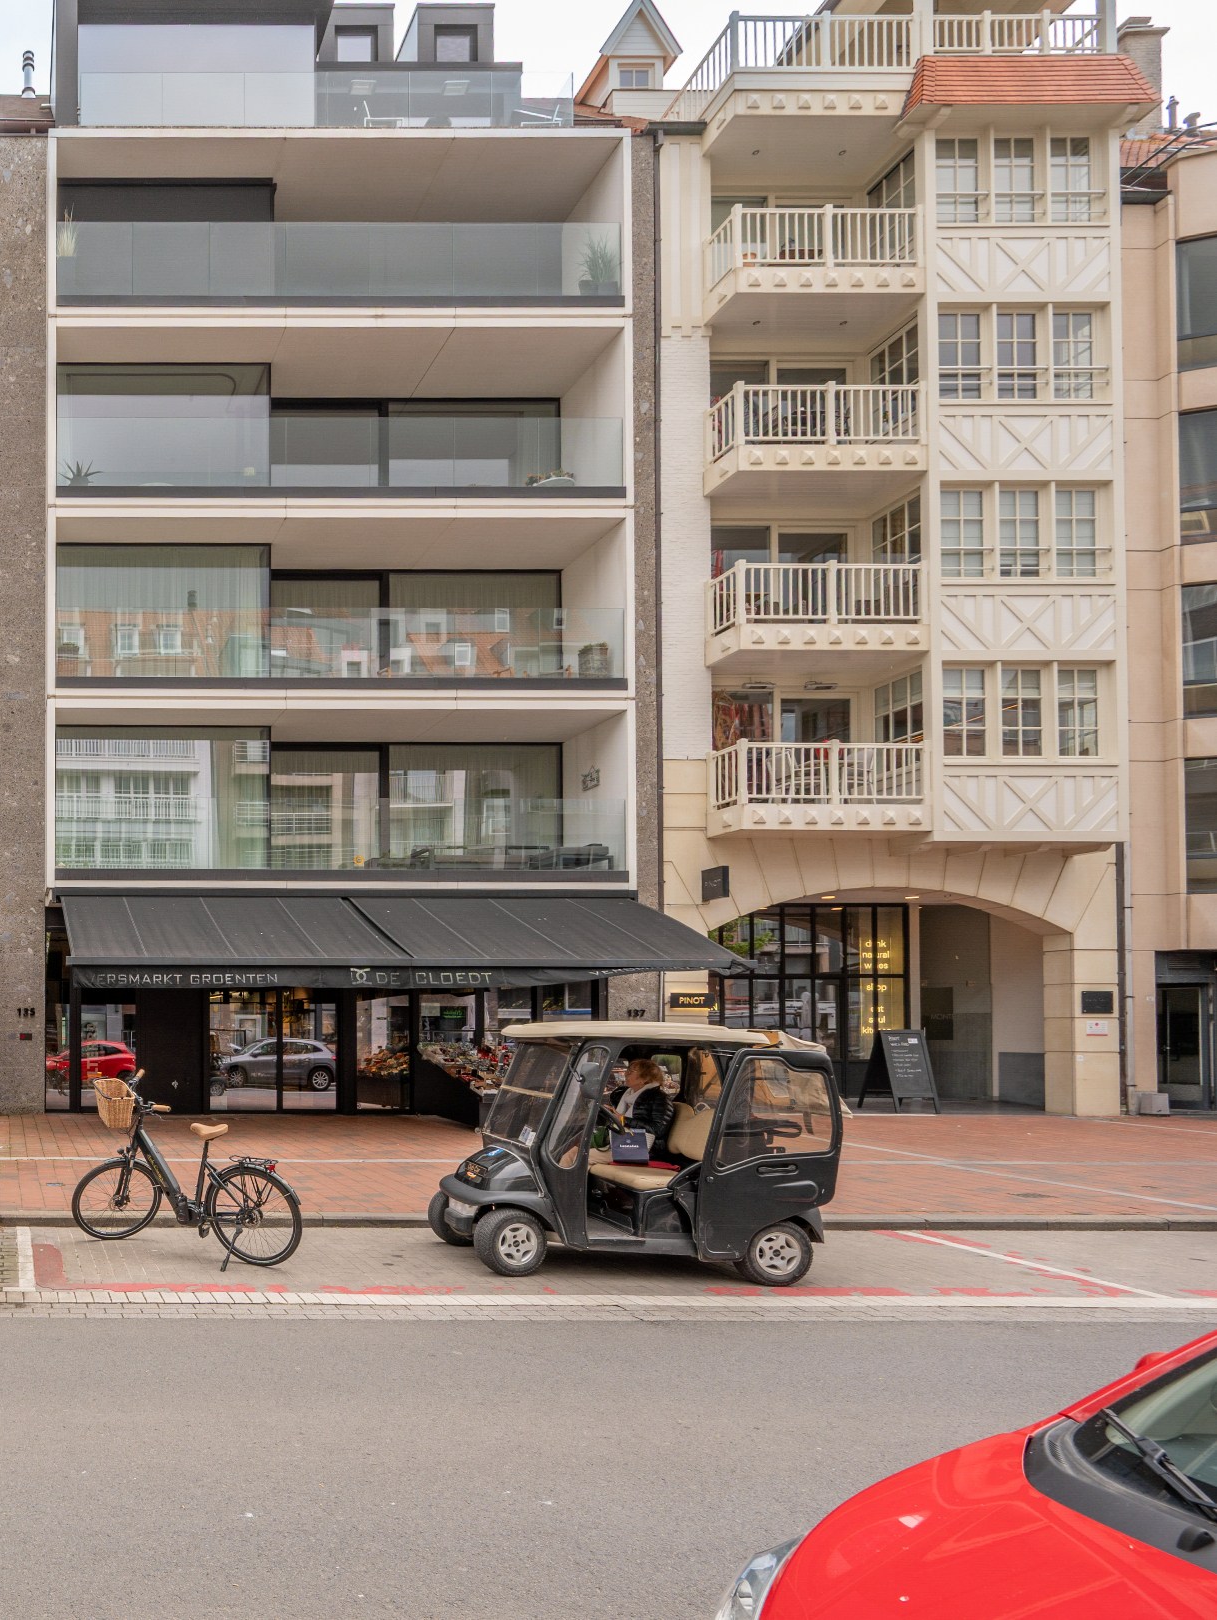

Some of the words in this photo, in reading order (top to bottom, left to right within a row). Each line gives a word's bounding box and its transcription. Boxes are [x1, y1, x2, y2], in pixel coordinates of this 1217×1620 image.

[862, 951, 890, 959] naural
[190, 973, 278, 985] GROENTEN
[376, 972, 400, 984] DE
[415, 972, 492, 985] CLOEDT
[679, 996, 705, 1005] PINOT
[868, 1016, 886, 1024] sul
